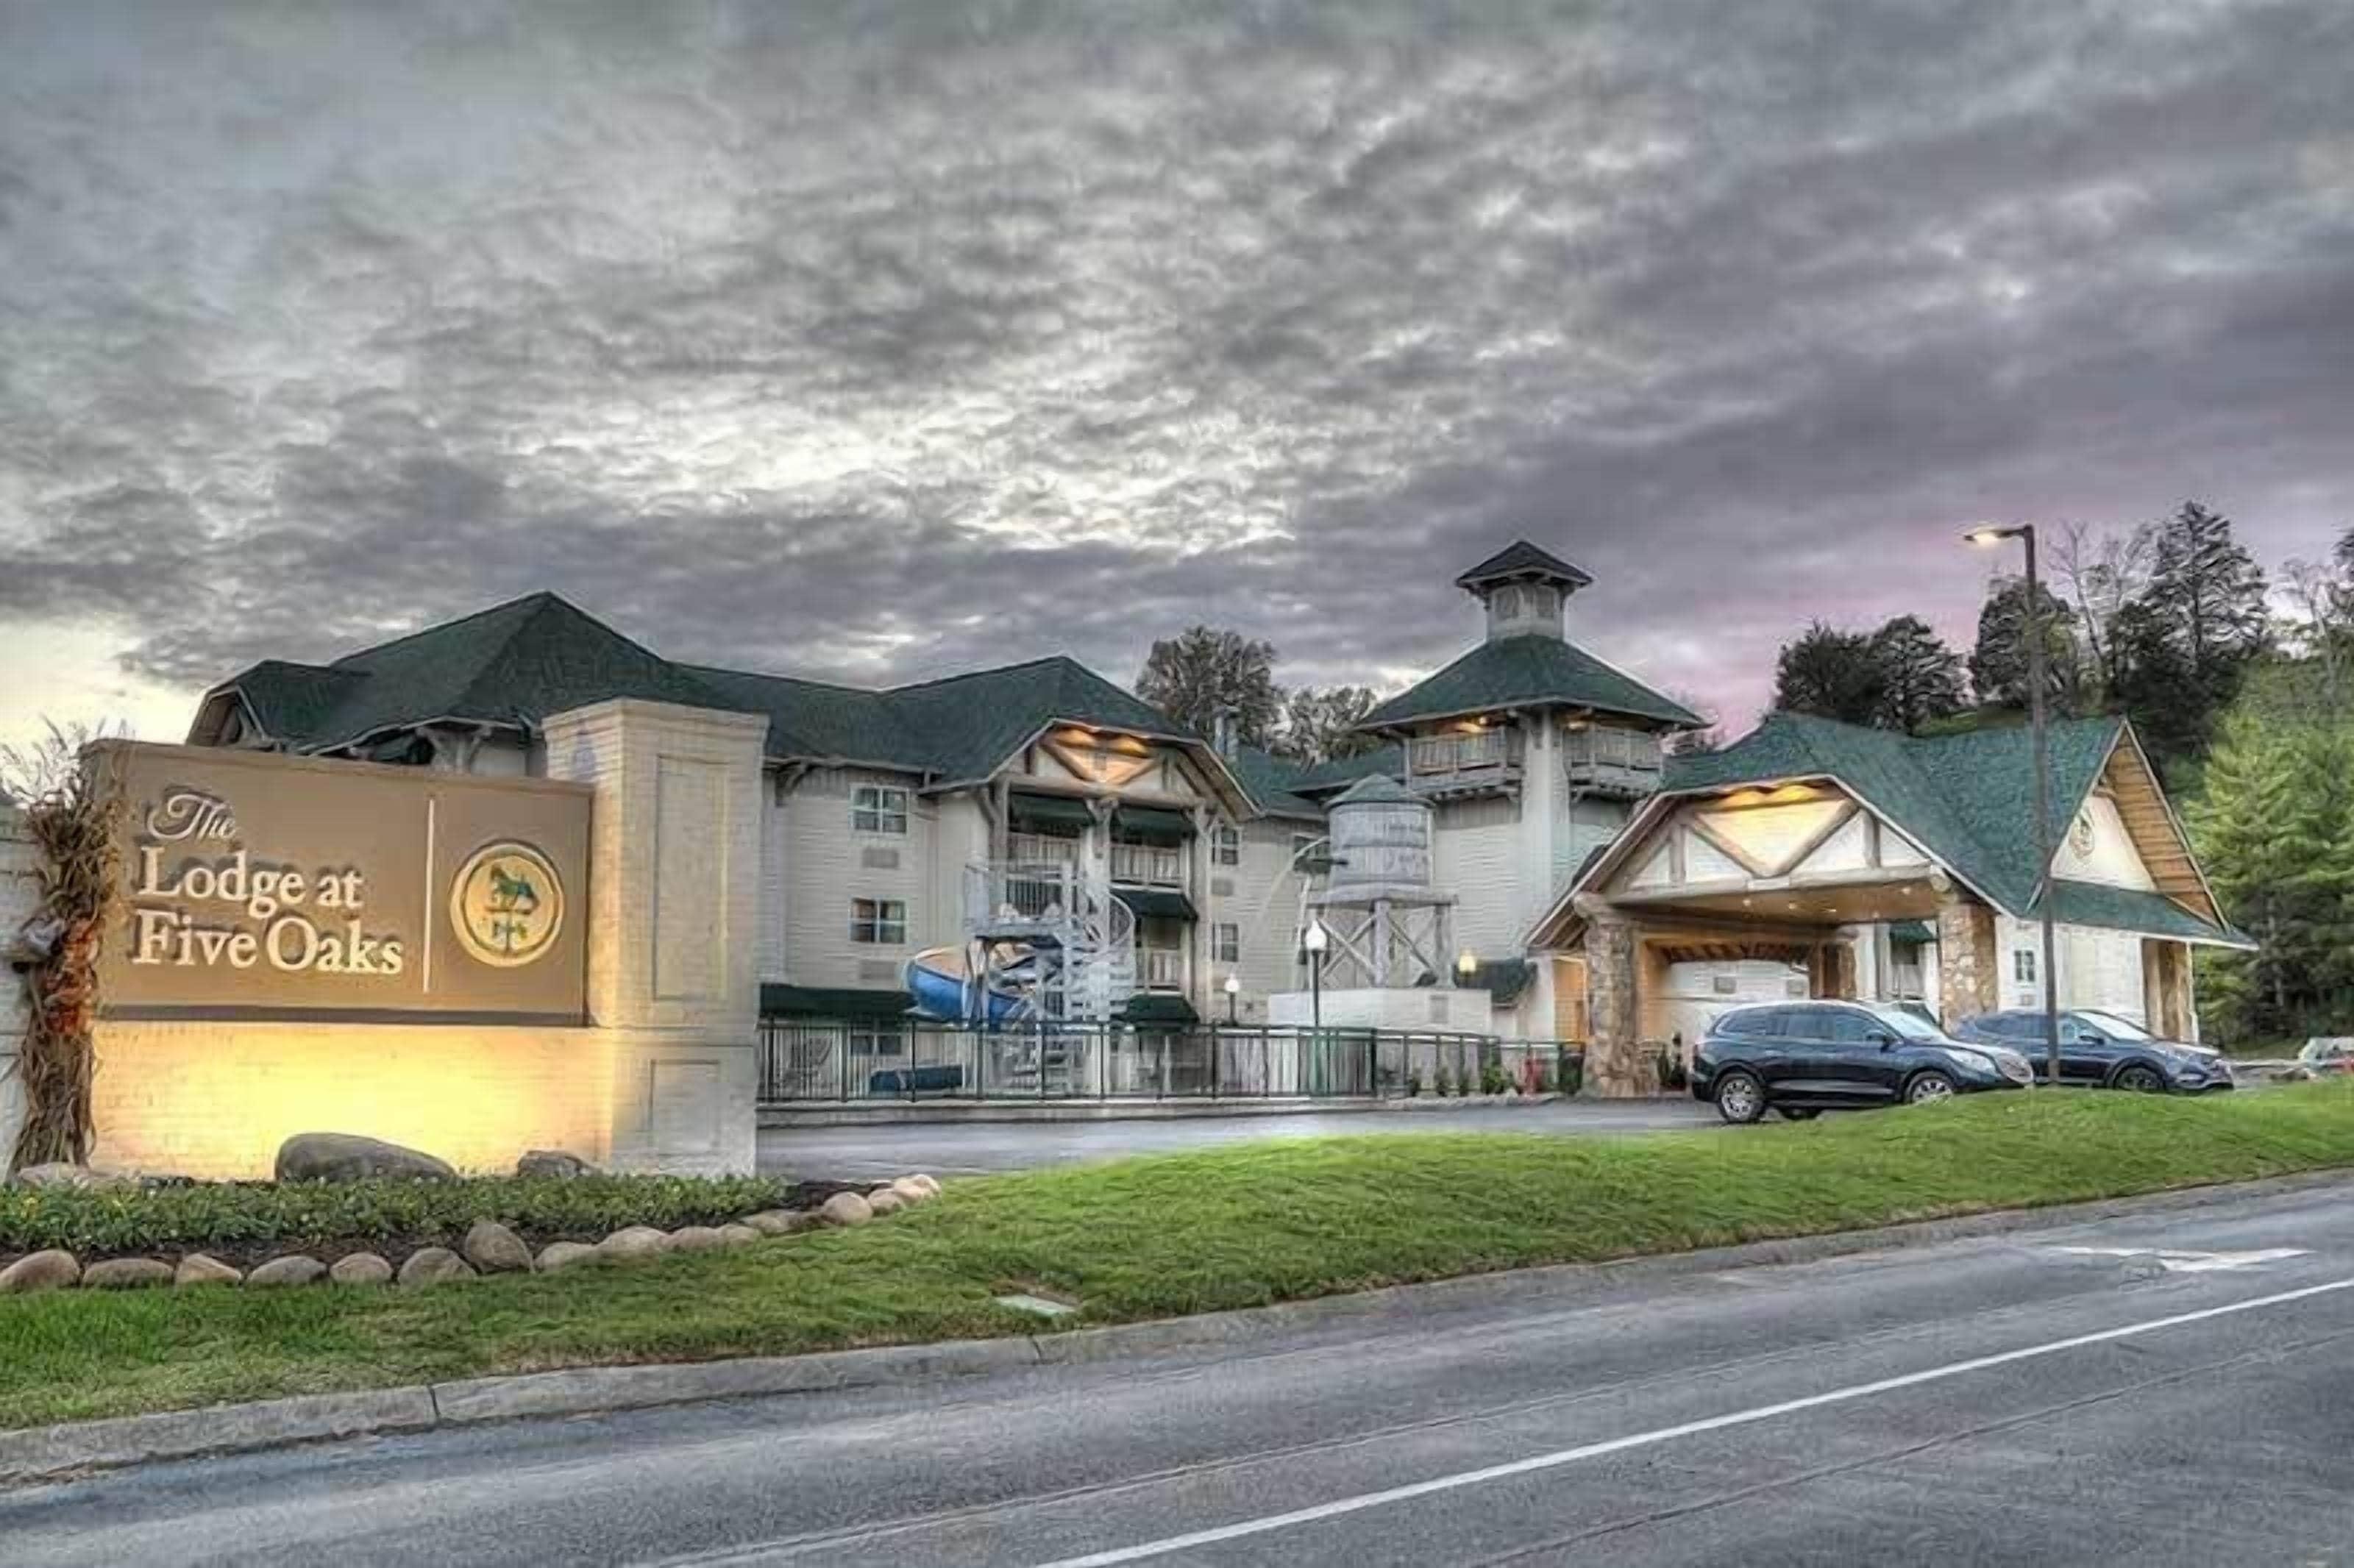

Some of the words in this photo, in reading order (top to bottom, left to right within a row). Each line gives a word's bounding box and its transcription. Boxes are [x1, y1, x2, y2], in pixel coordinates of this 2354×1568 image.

[146, 794, 236, 842] The
[137, 847, 307, 919] Lodge
[316, 870, 365, 910] at
[132, 909, 257, 969] Five
[266, 916, 404, 974] Oaks
